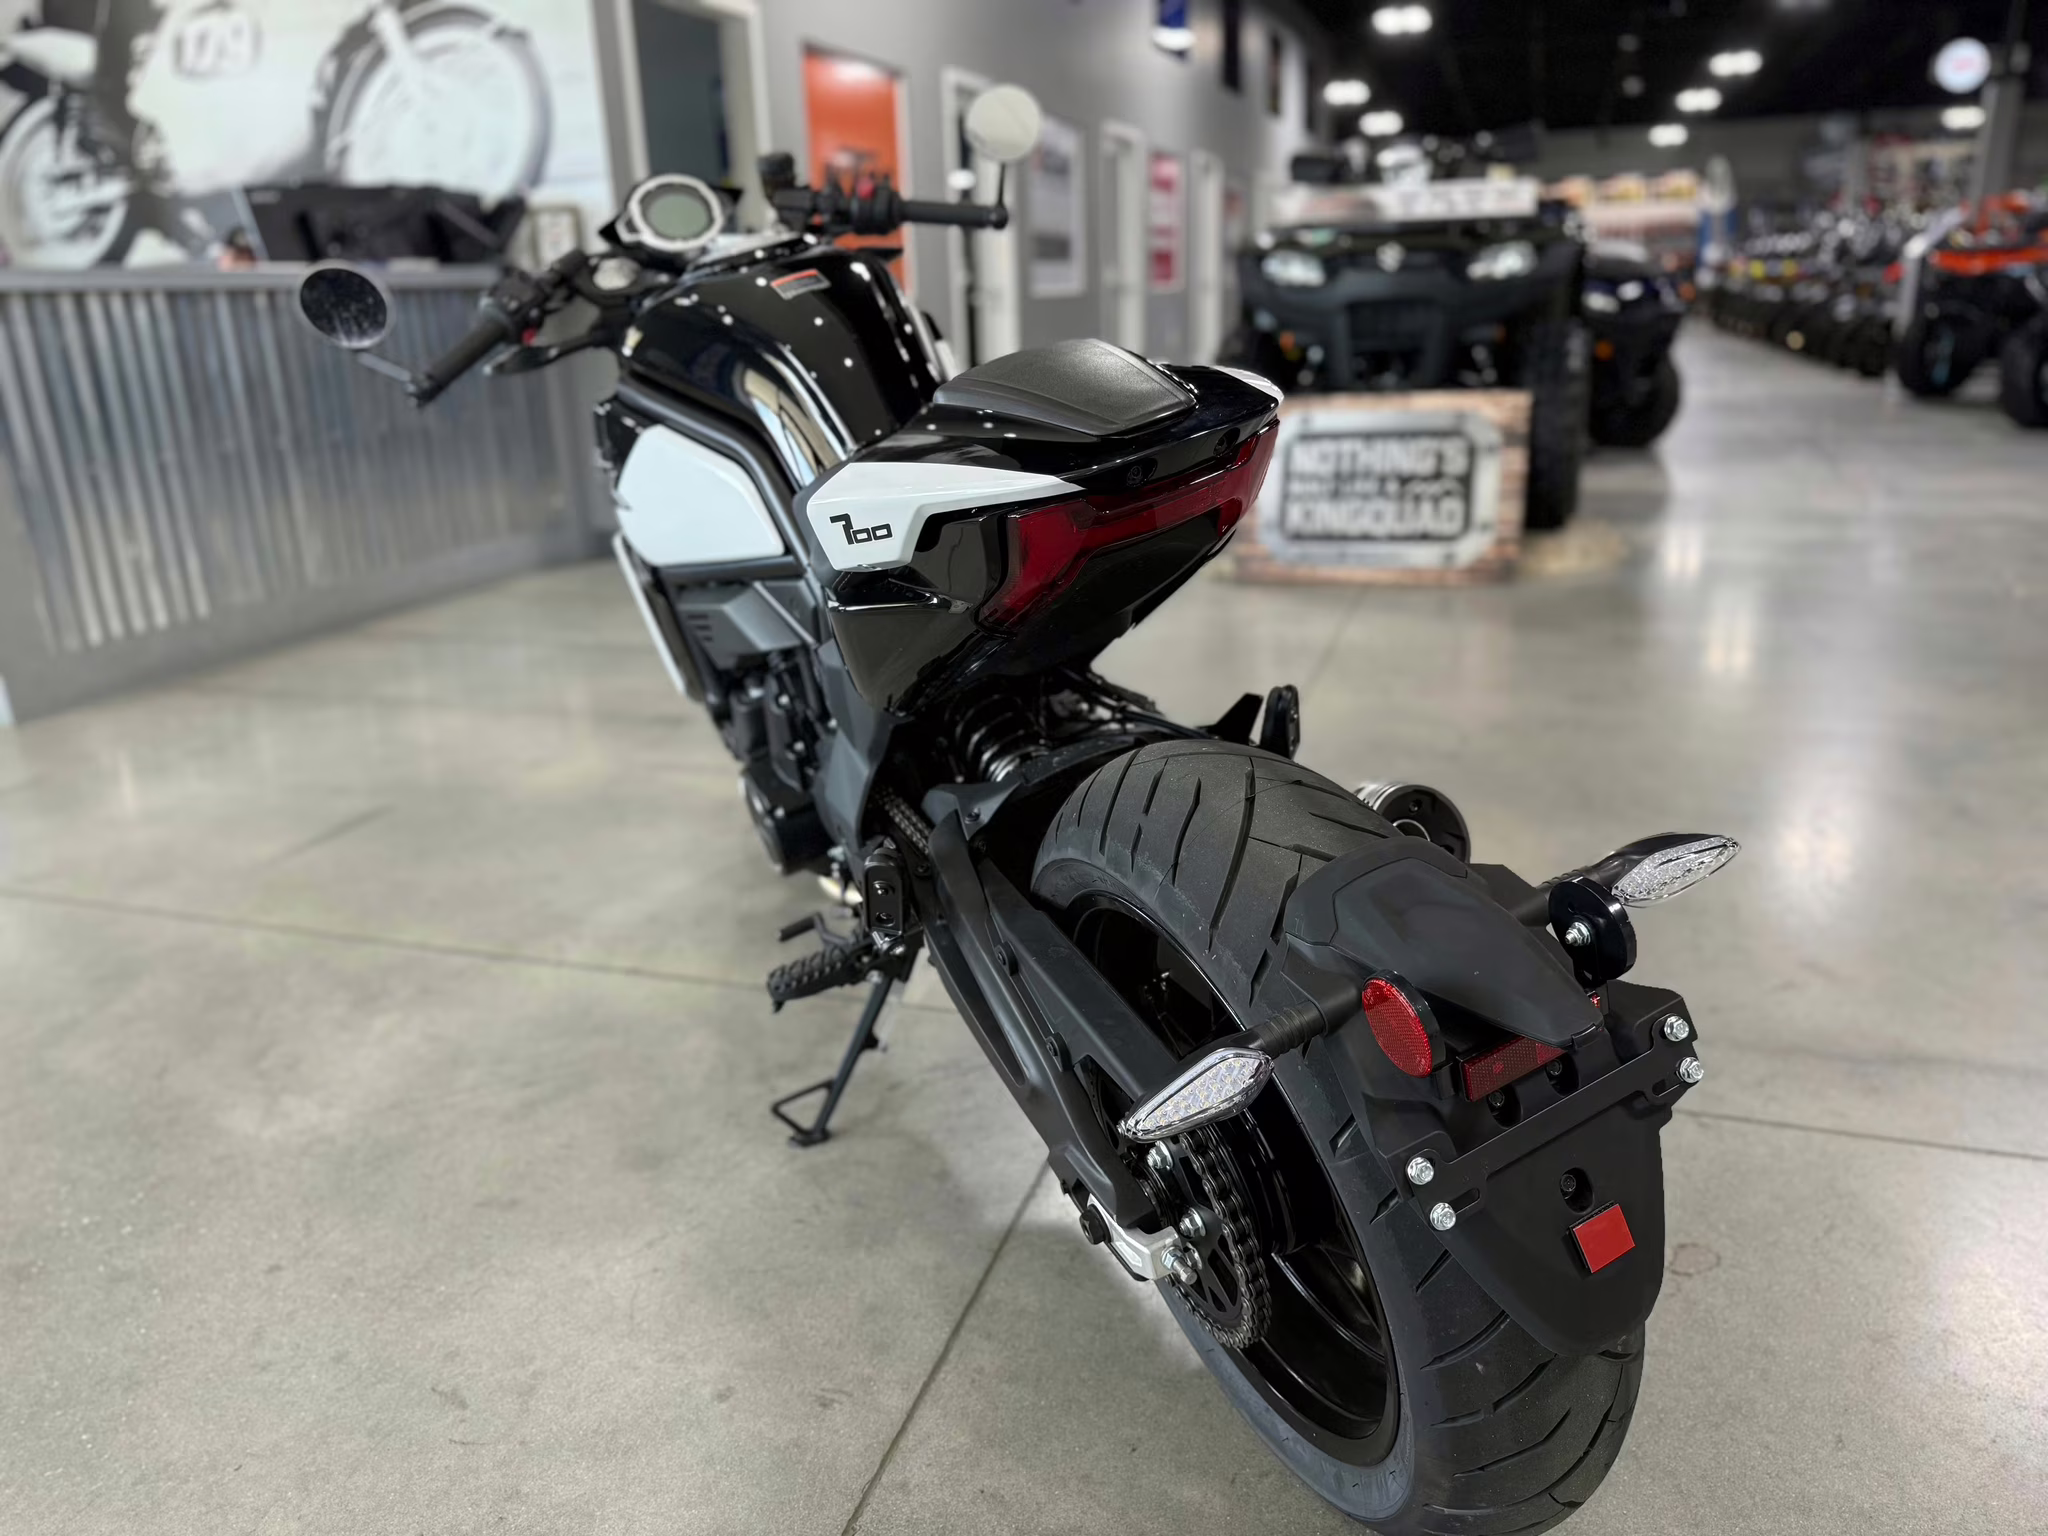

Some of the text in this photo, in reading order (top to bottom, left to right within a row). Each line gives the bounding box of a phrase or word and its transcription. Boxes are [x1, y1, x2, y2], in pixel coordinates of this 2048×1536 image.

[1292, 437, 1469, 478] NOTHING'S
[829, 513, 893, 545] 700
[1284, 496, 1466, 536] KINGQUAD
